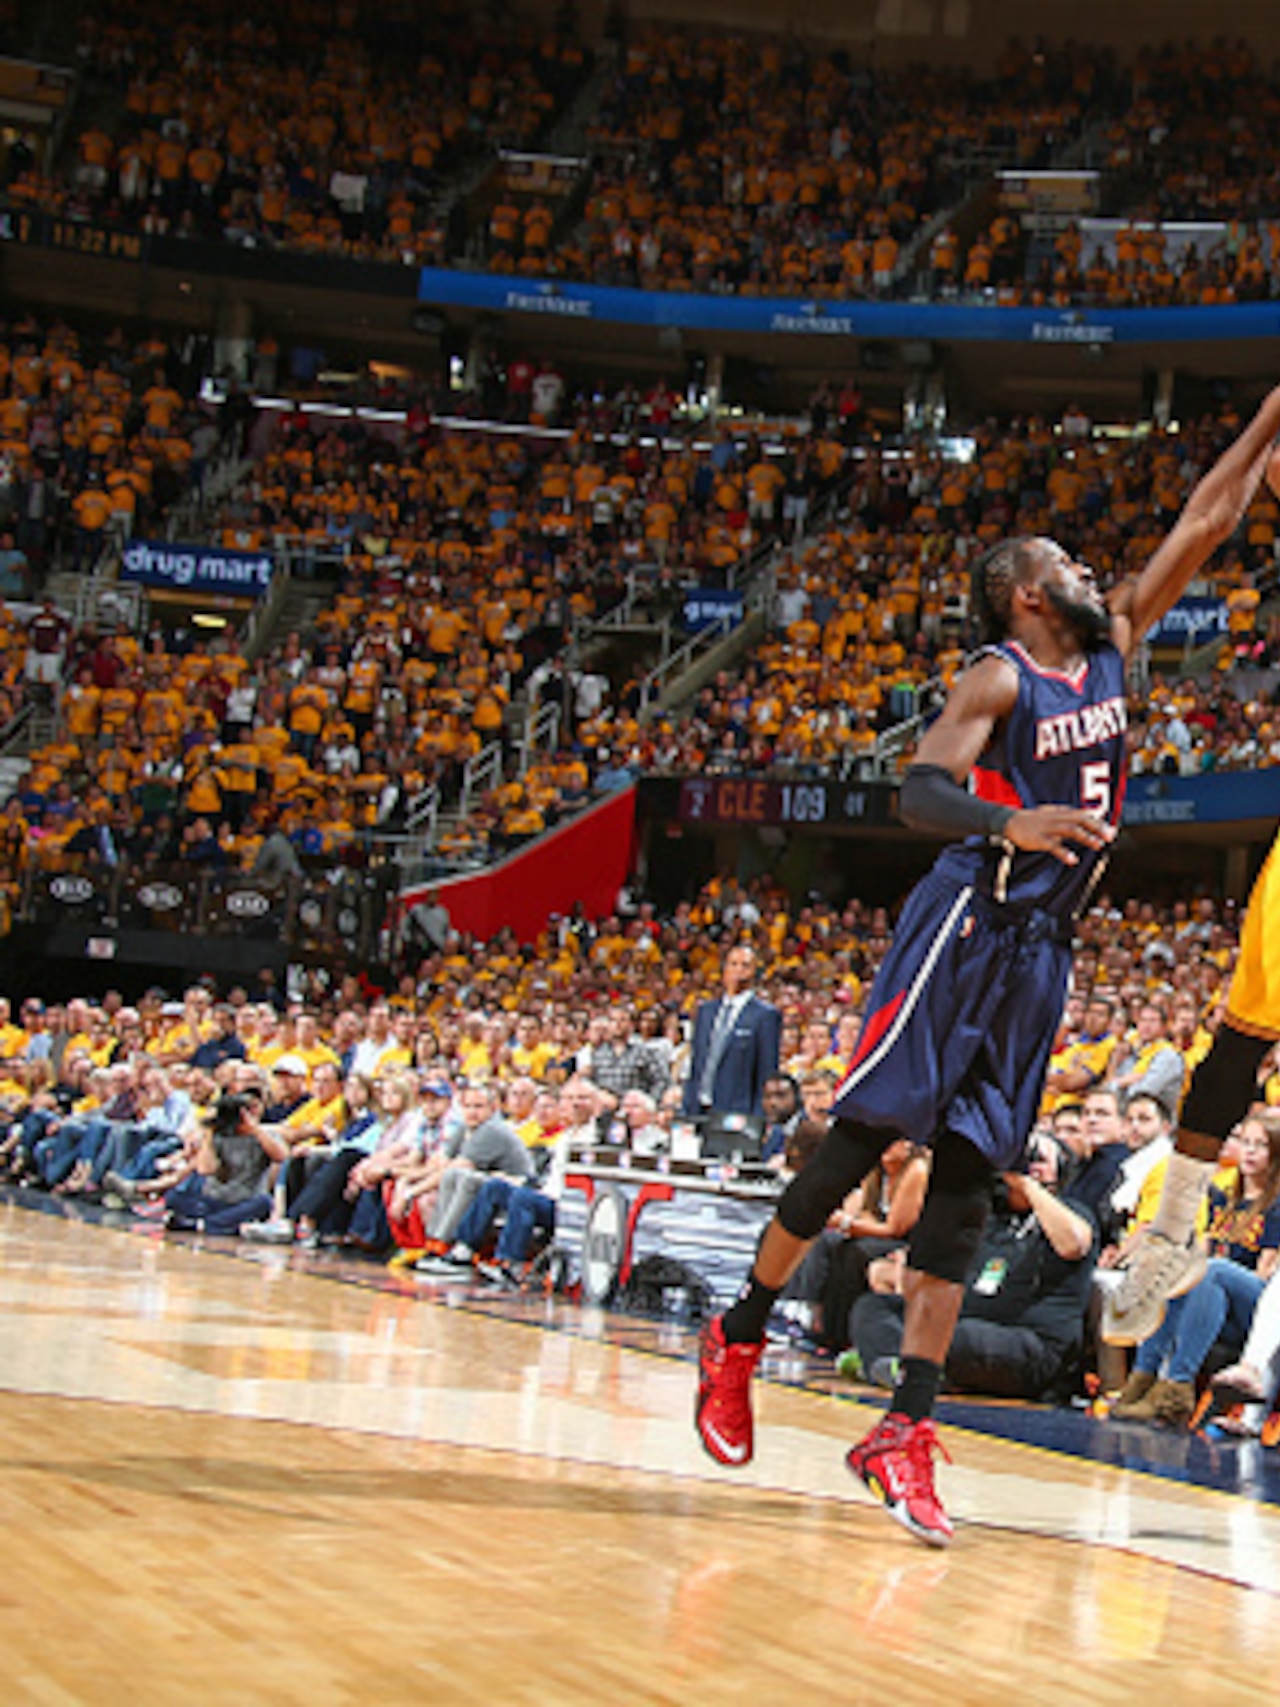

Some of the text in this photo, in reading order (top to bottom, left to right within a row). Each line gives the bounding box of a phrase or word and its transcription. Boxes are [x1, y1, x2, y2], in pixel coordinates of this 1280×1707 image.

[123, 544, 272, 584] drug mart
[717, 782, 767, 820] CLE
[1081, 761, 1110, 821] 5
